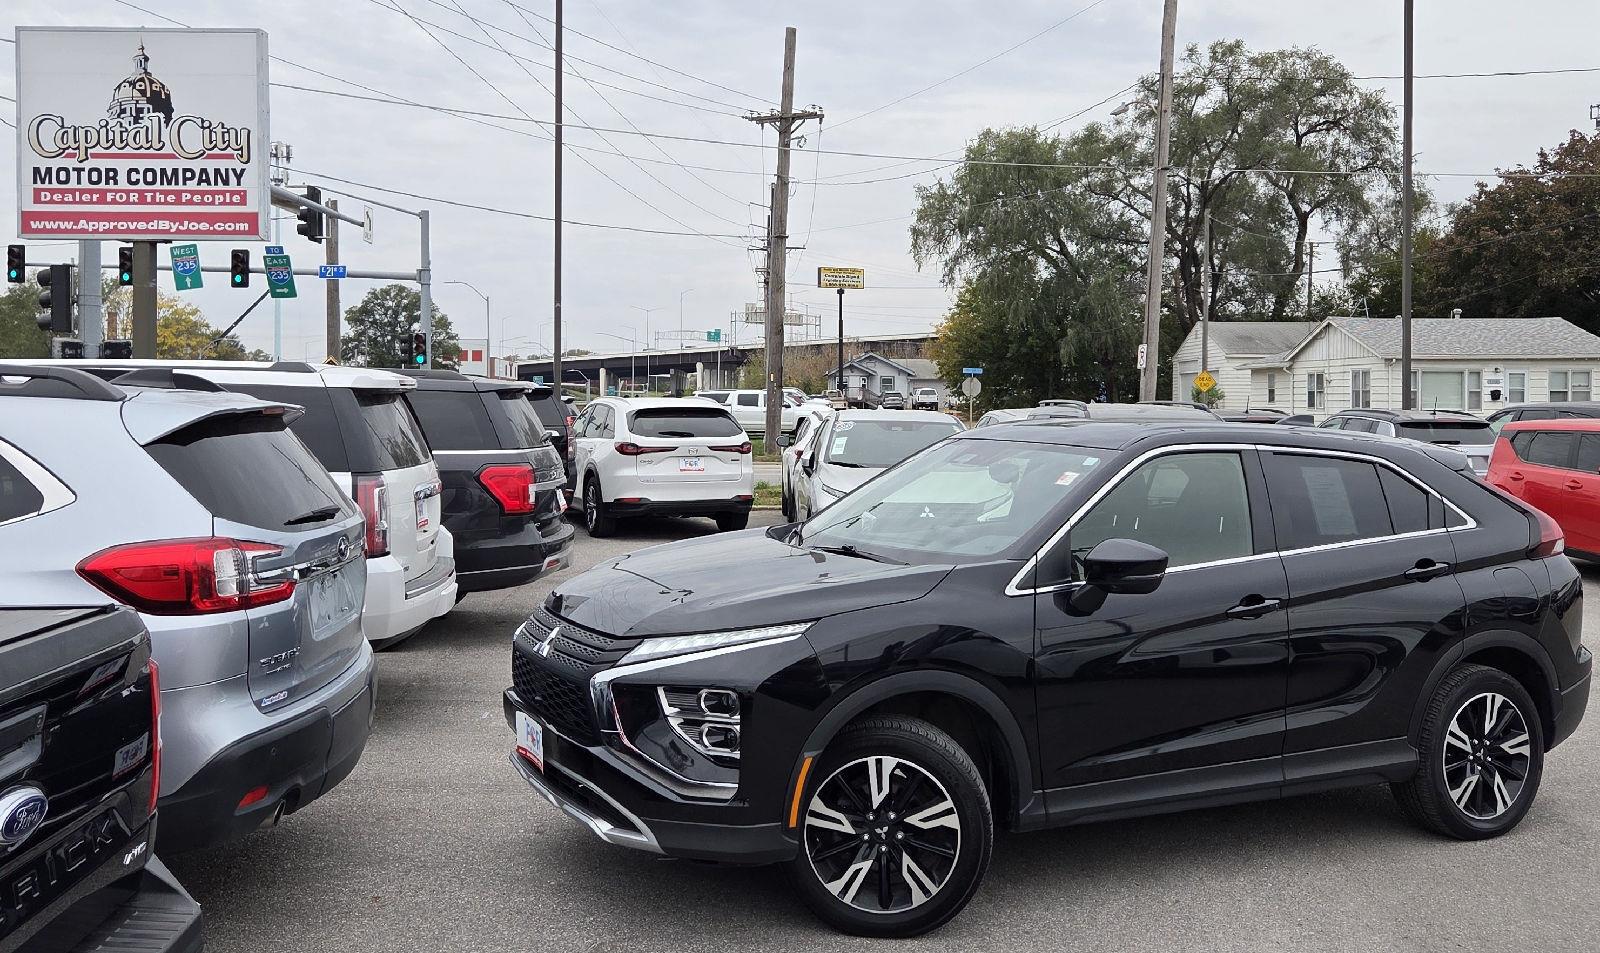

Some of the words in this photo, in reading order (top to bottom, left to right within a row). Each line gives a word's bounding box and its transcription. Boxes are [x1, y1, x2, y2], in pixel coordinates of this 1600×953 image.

[28, 114, 164, 162] Capital
[169, 115, 251, 164] City
[33, 166, 119, 186] MOTOR
[126, 167, 246, 187] COMPANY
[40, 191, 100, 202] Dealer
[106, 192, 139, 203] FOR
[144, 192, 176, 203] The
[30, 219, 249, 232] www.ApprovedByJoe.com
[177, 260, 197, 271] 235
[271, 270, 289, 280] 235
[14, 801, 41, 835] Ford
[0, 818, 113, 924] RICK
